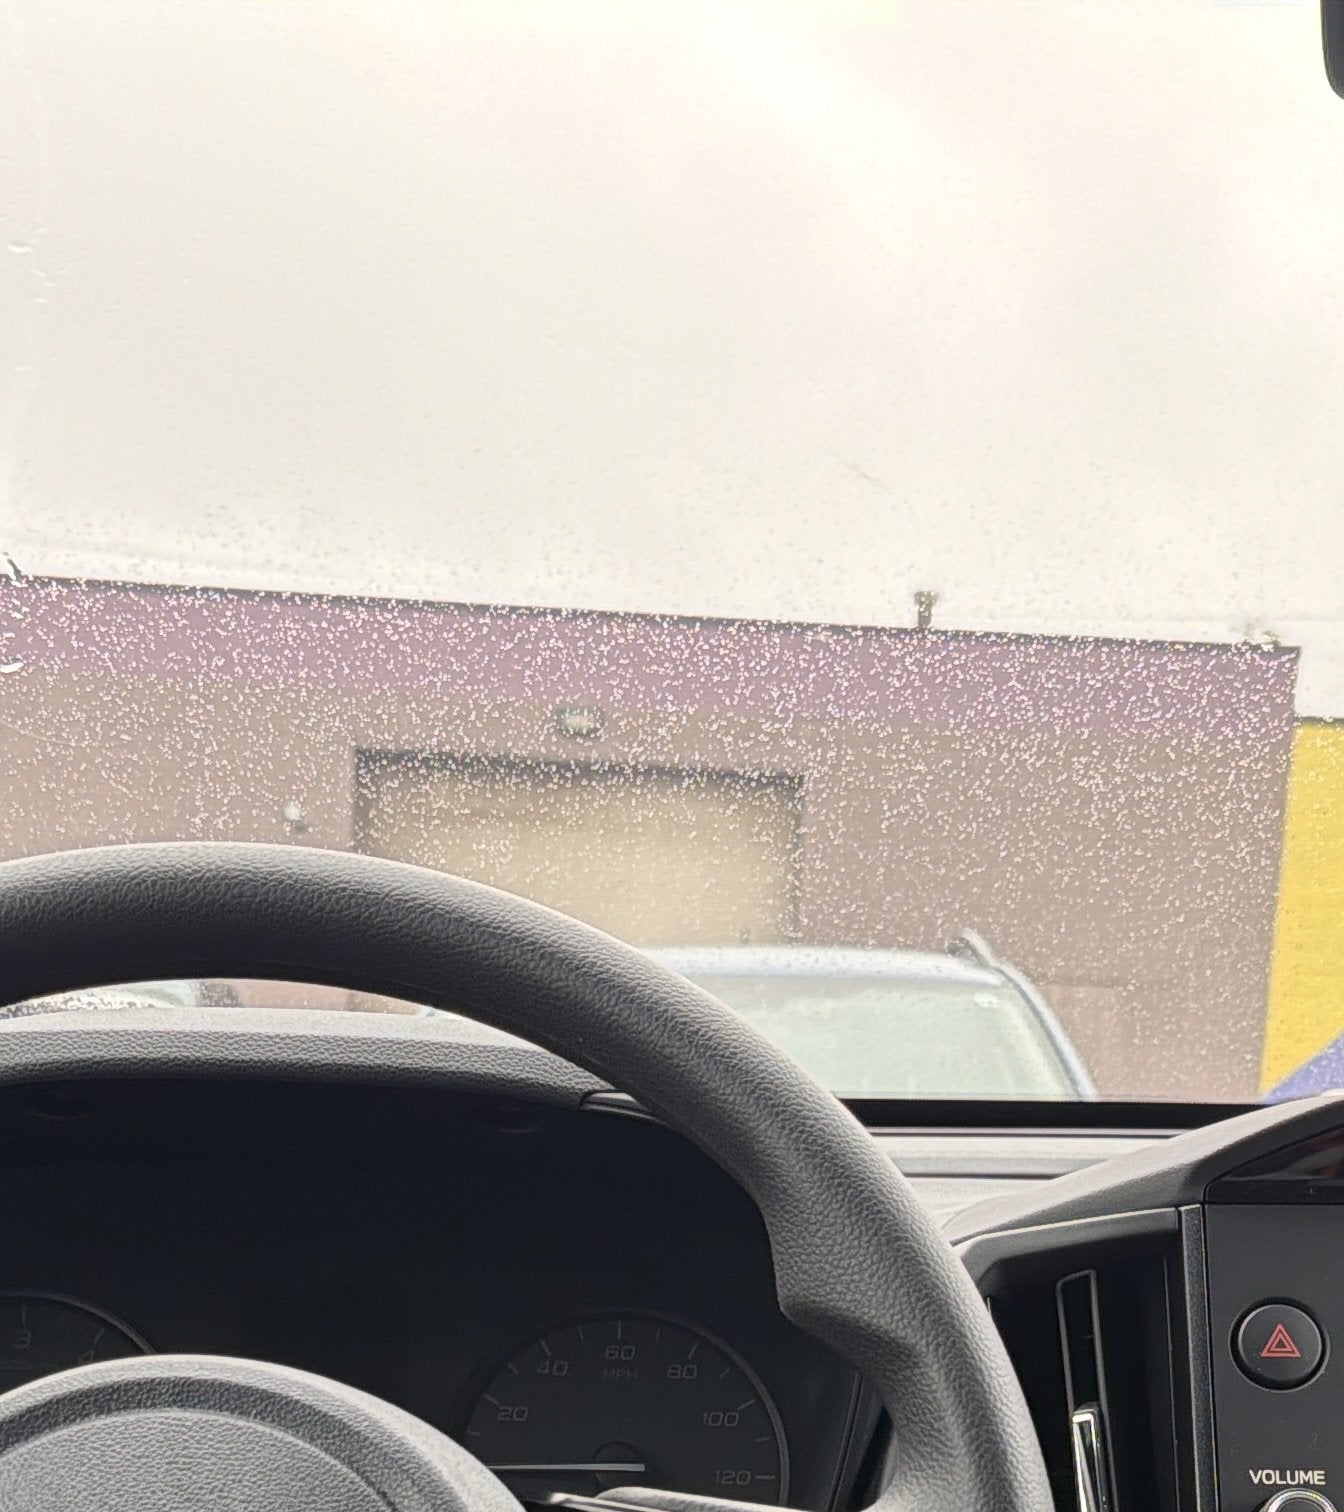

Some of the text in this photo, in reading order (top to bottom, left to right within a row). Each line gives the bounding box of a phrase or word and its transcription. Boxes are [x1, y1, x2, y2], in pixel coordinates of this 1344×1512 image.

[604, 1344, 636, 1361] 60
[536, 1360, 569, 1377] 40
[666, 1364, 698, 1380] 80
[496, 1405, 530, 1422] 20
[702, 1411, 741, 1428] 100
[714, 1470, 752, 1487] 120
[1248, 1469, 1326, 1486] VOLUME
